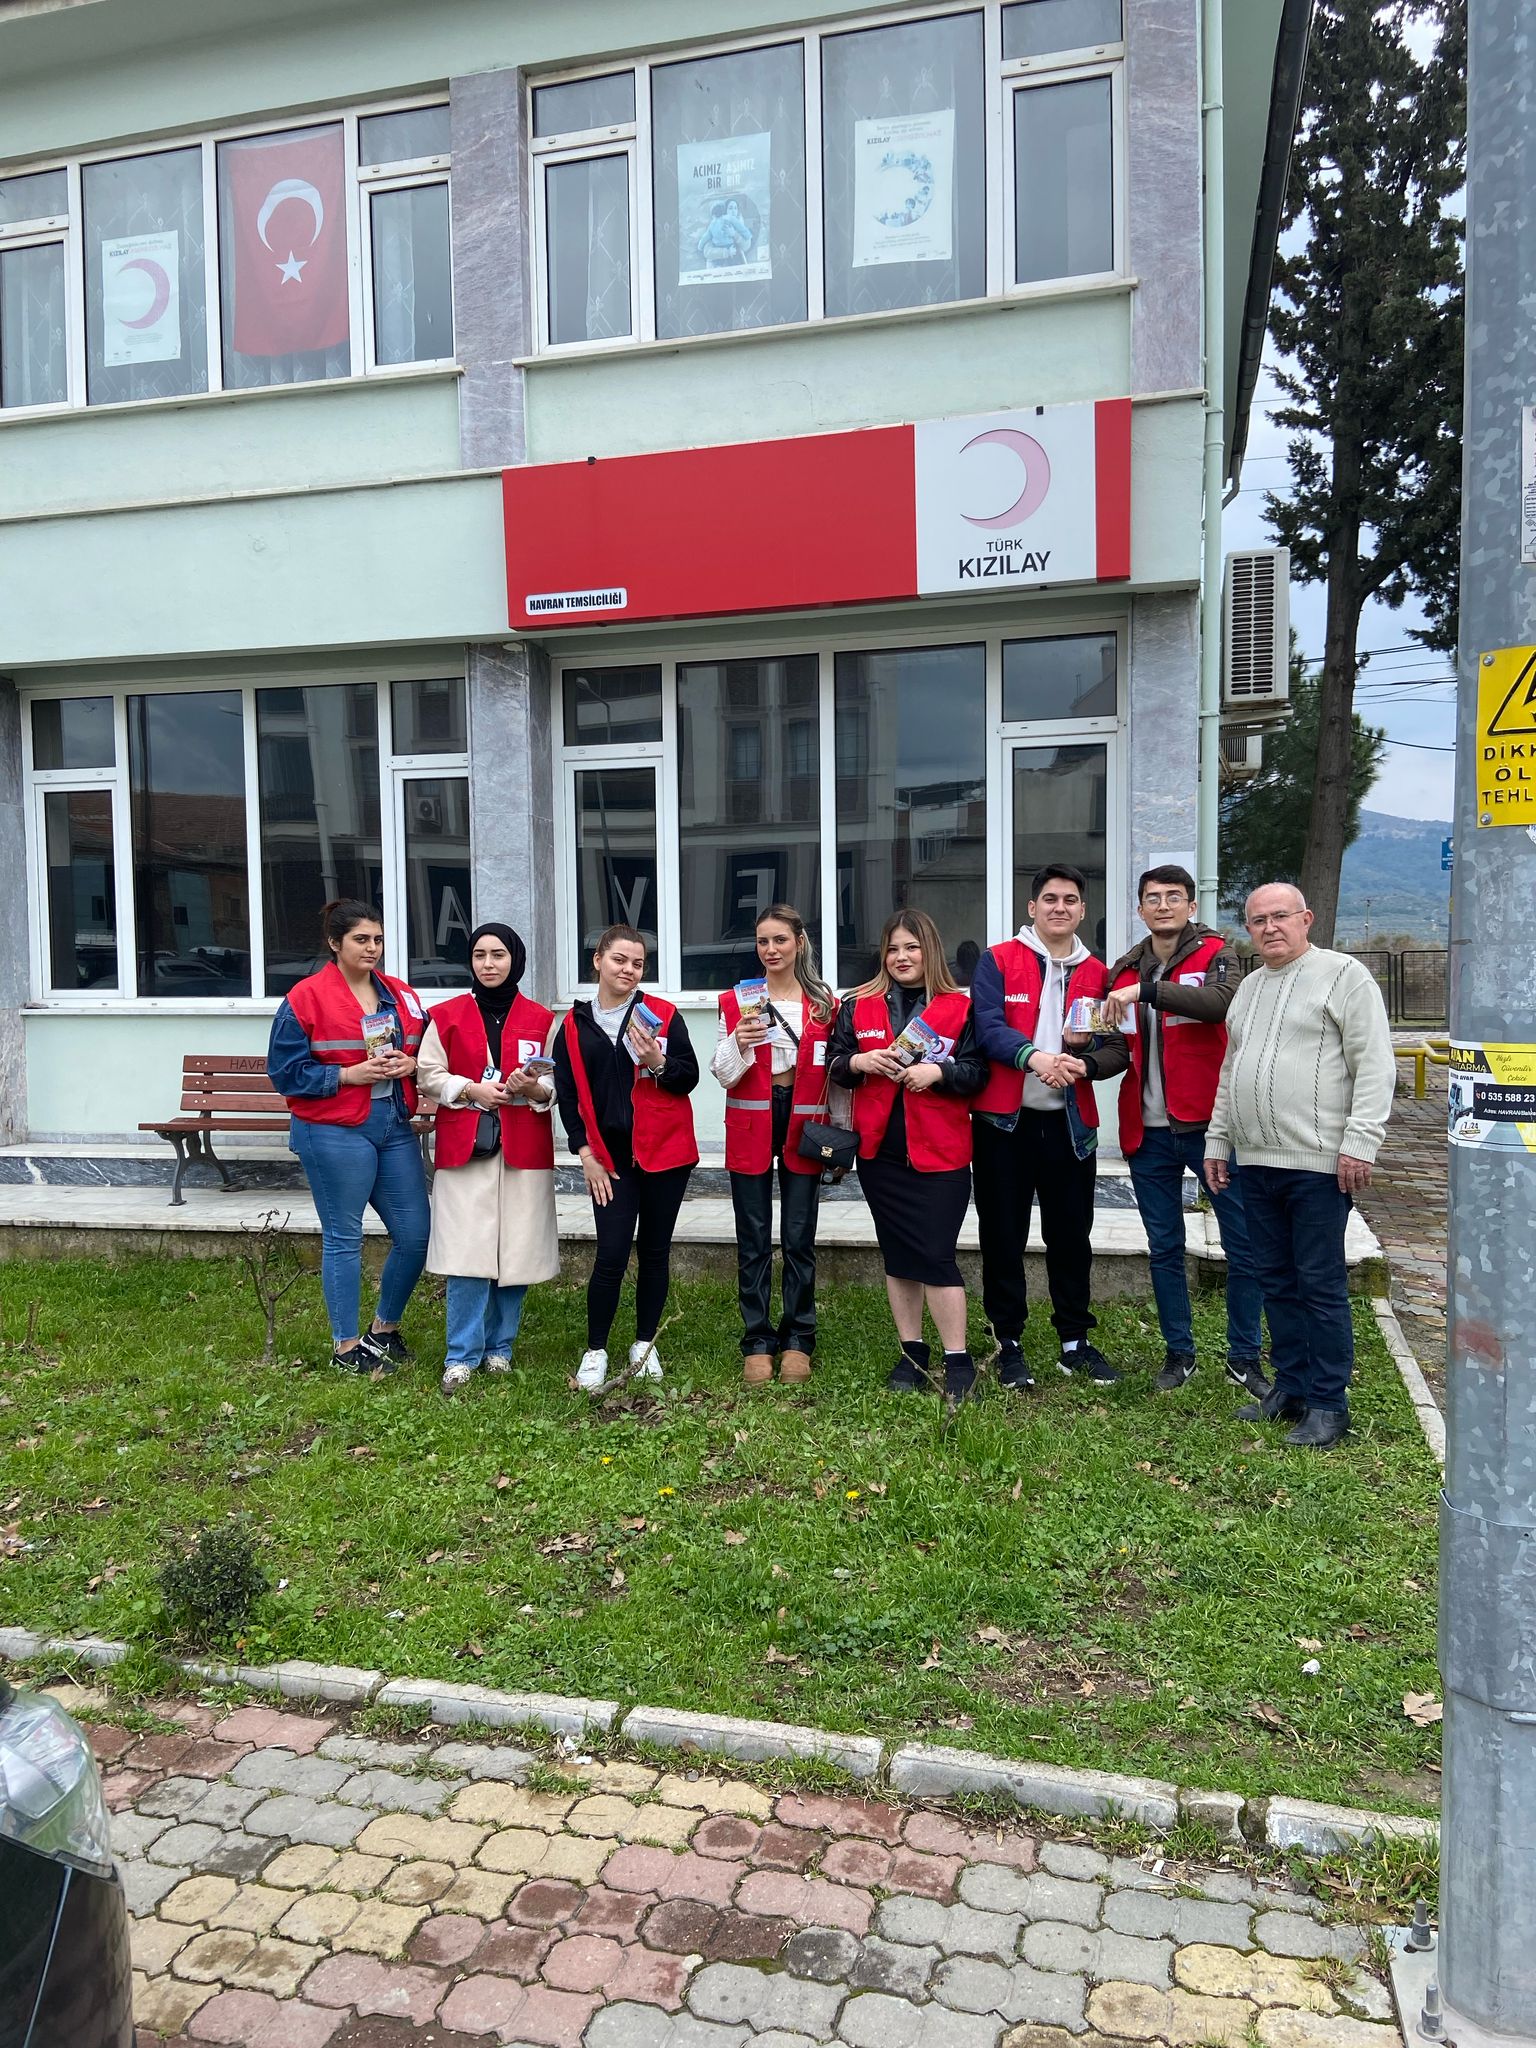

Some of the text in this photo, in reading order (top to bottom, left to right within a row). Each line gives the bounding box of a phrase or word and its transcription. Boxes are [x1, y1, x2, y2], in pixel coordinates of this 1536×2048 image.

[693, 163, 722, 178] ACIMIZ
[986, 538, 1023, 552] TÜRK
[958, 551, 1051, 579] KIZILAY
[529, 591, 622, 610] HAVRAN TEMSİLCİLİĞİ
[1482, 788, 1534, 805] TEHL
[1481, 1091, 1536, 1103] 0 535 588 23
